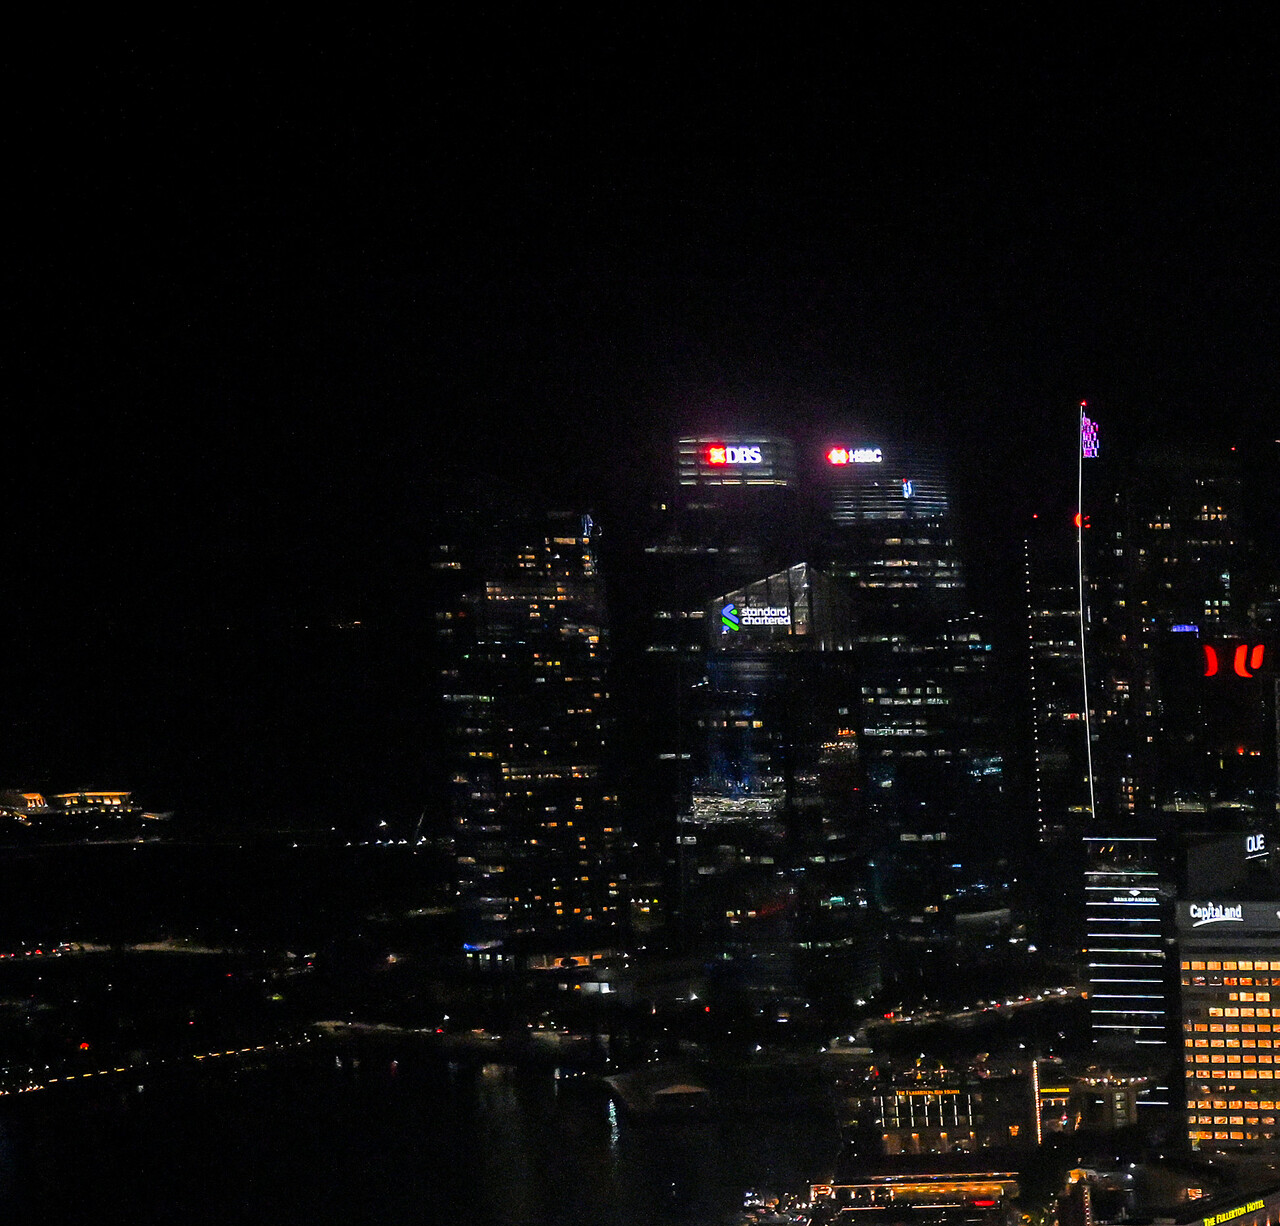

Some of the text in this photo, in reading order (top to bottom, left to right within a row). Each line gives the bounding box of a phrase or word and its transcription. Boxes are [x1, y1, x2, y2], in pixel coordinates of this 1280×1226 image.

[726, 447, 762, 463] DBS
[849, 449, 883, 462] HSBC
[742, 607, 789, 617] standard
[743, 616, 791, 626] chartered
[1247, 834, 1266, 853] OUE
[1190, 902, 1242, 922] CapitaLand
[1216, 1205, 1247, 1224] FULLERTON
[1246, 1199, 1265, 1213] HOTEL
